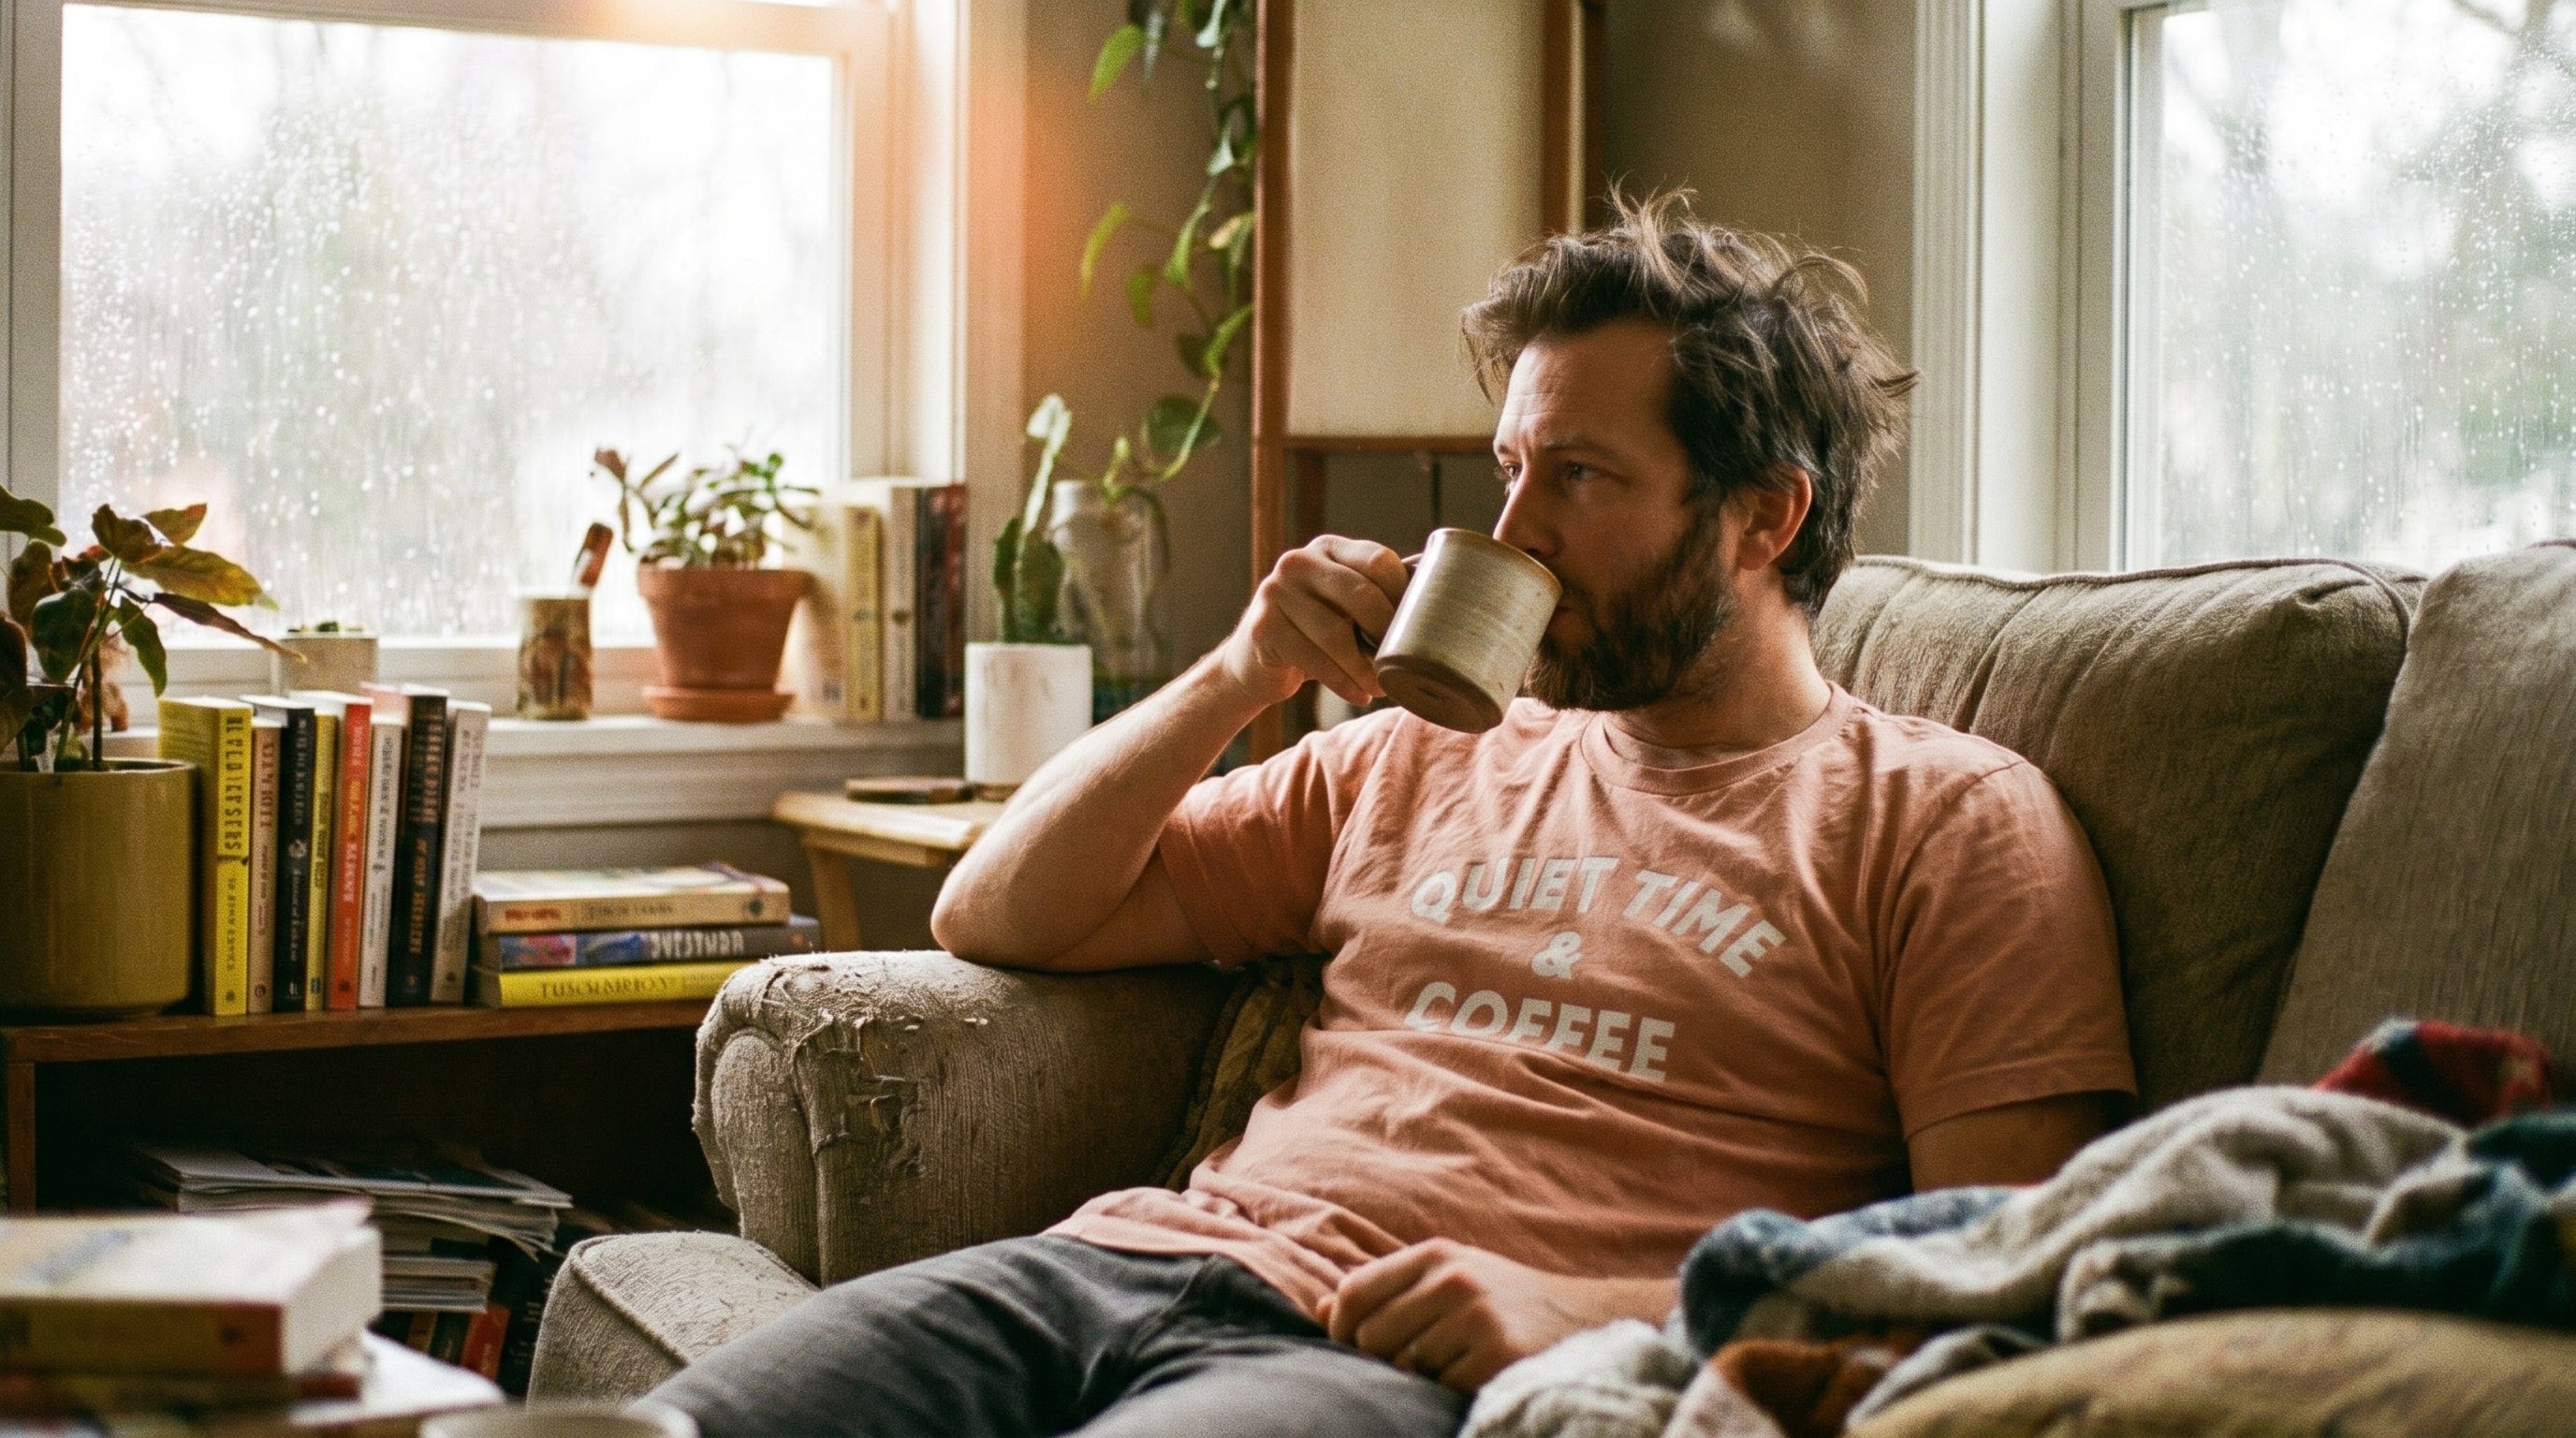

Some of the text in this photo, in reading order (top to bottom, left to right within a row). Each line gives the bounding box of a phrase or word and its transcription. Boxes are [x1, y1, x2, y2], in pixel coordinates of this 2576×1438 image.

[1411, 857, 1786, 978] QUIET TIME
[1531, 931, 1582, 980] &
[1404, 981, 1676, 1083] COFFEE
